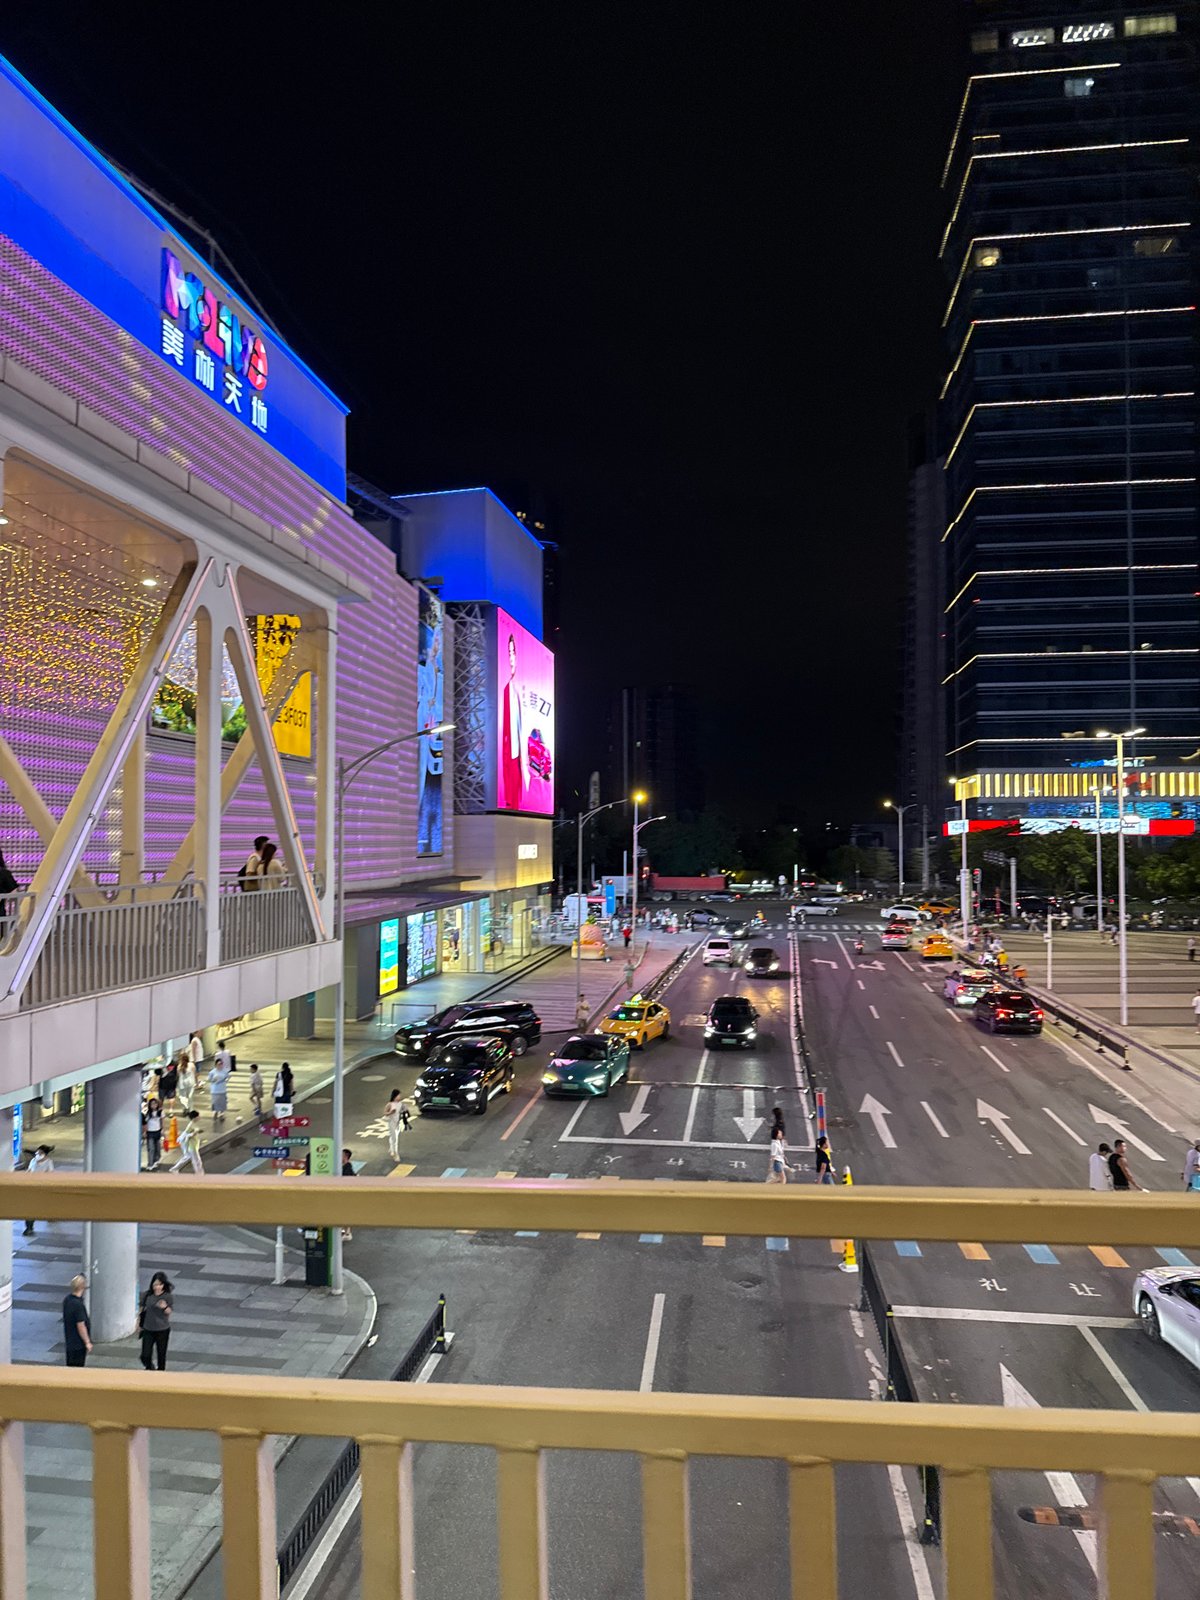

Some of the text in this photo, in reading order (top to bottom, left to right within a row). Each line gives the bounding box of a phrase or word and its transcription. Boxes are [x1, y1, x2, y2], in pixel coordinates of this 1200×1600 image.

[163, 318, 268, 433] 美林天地
[978, 1277, 1102, 1297] 礼让
